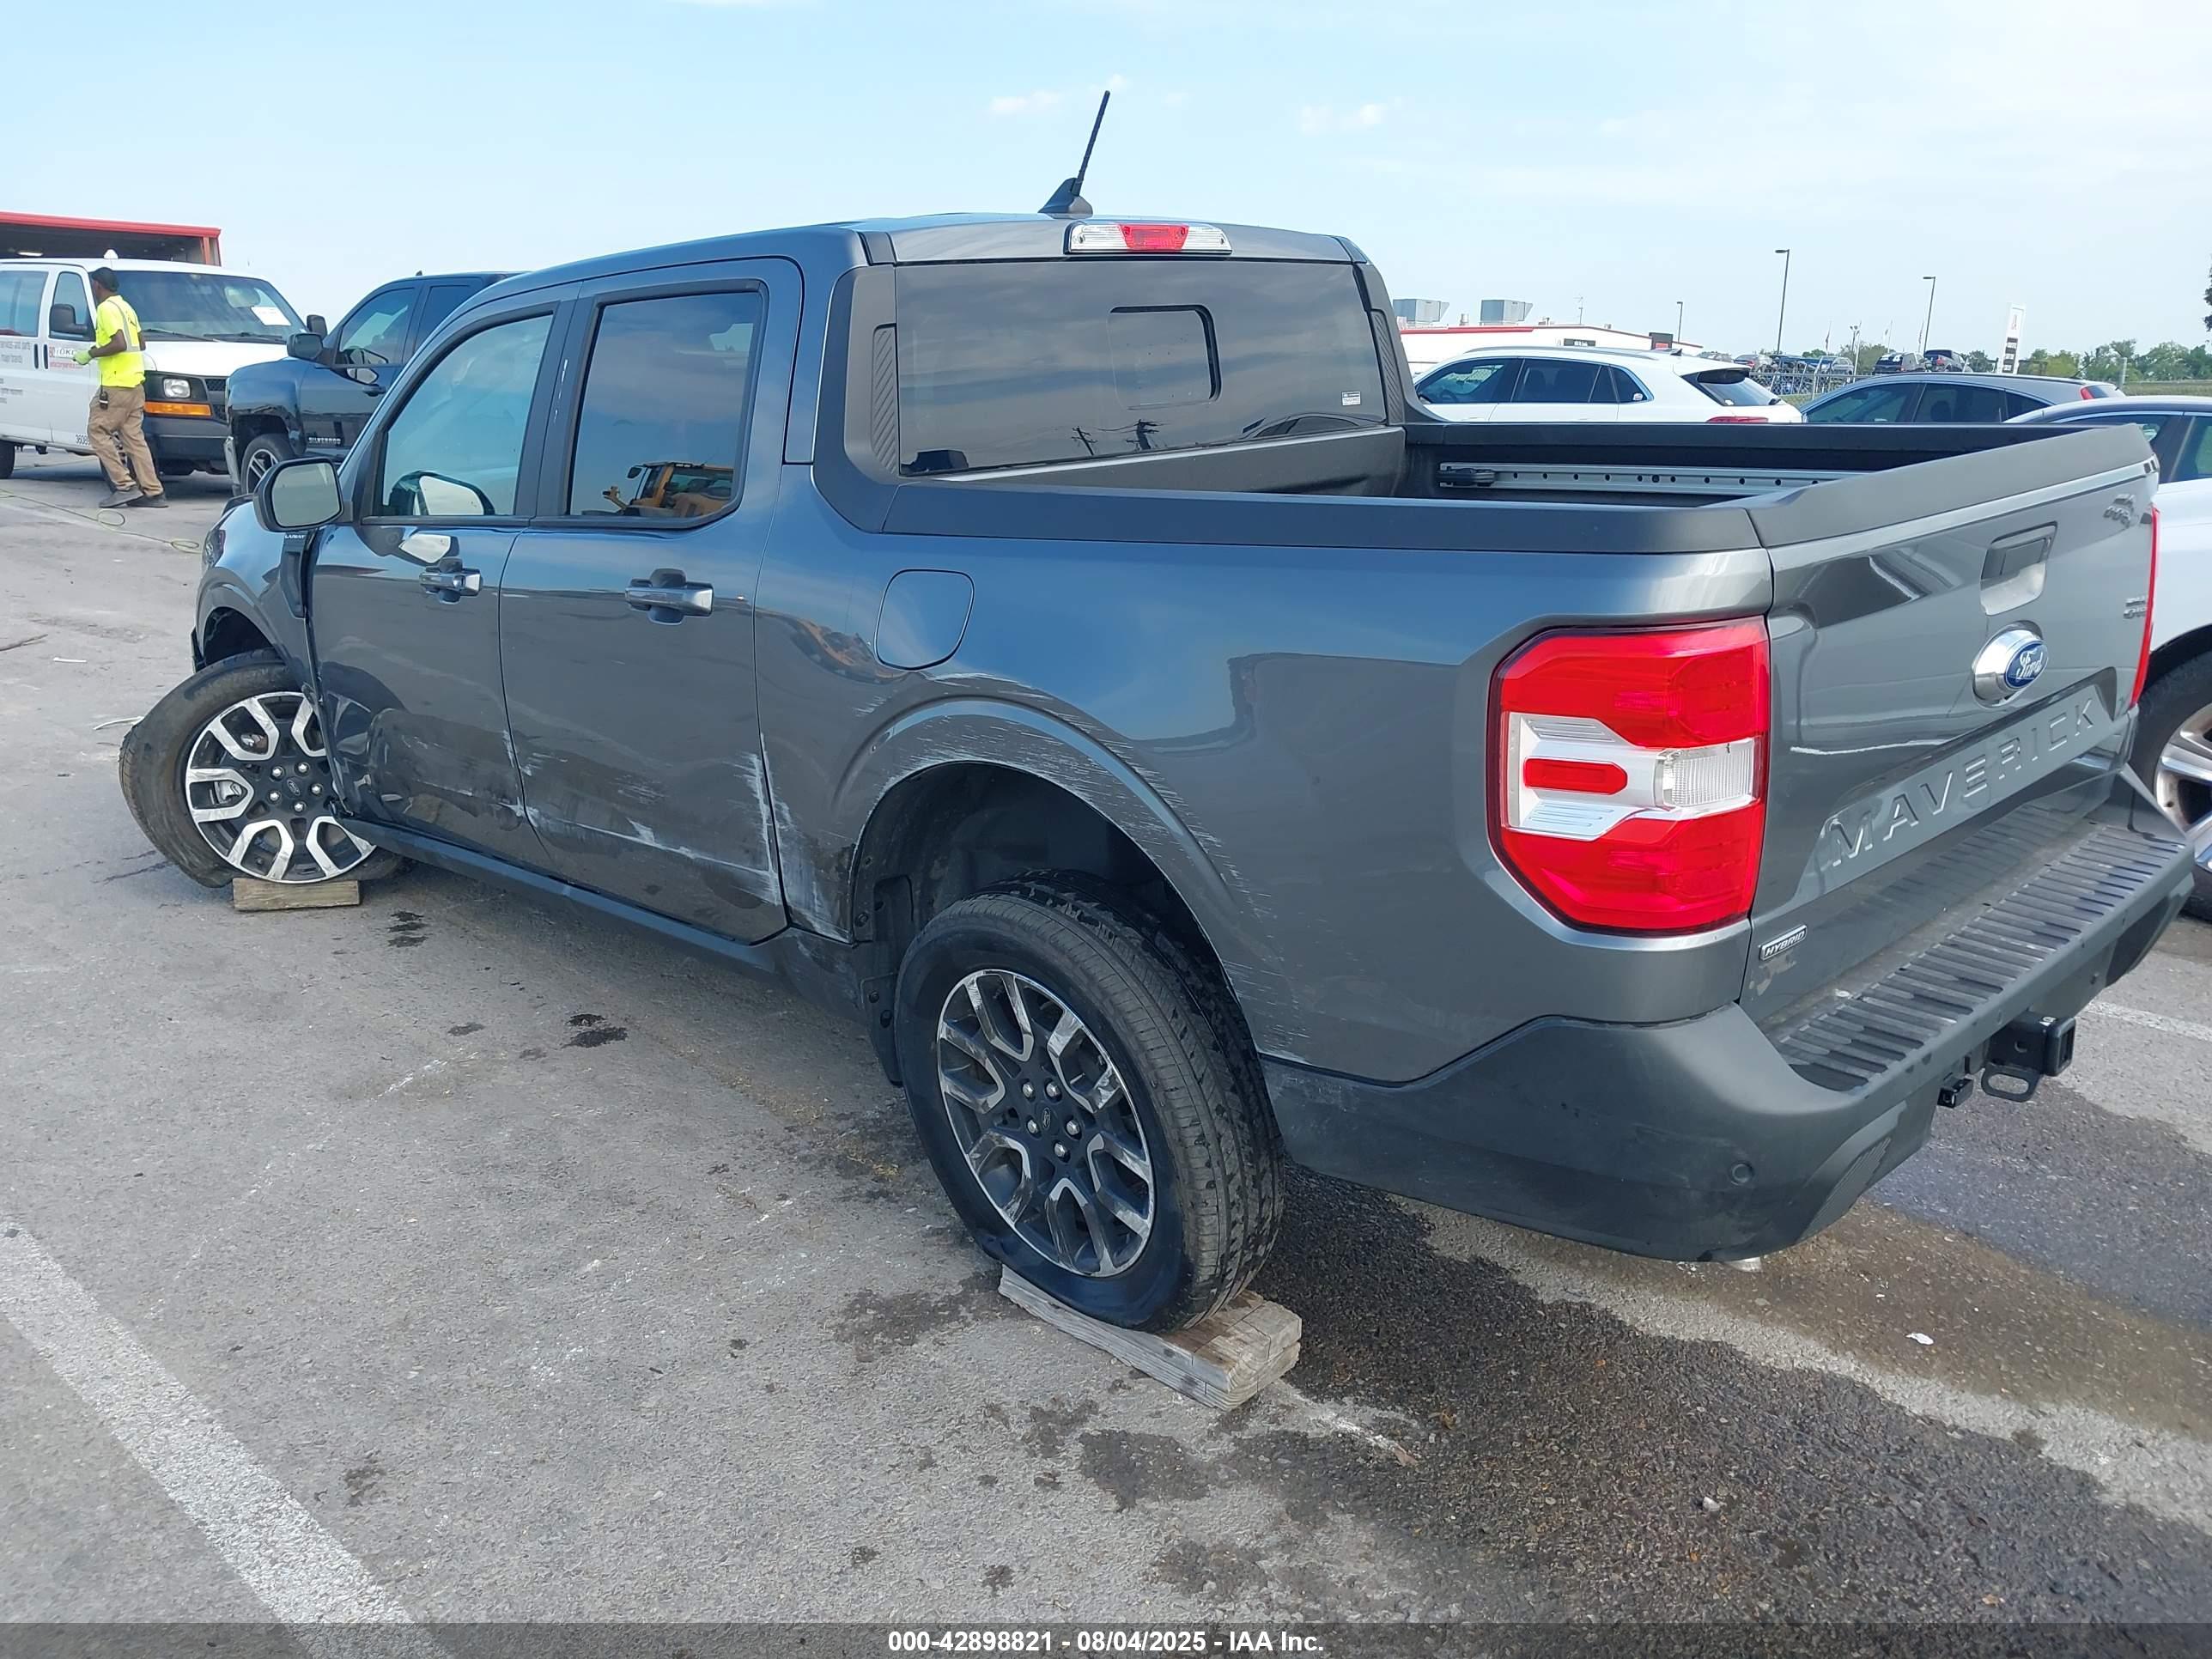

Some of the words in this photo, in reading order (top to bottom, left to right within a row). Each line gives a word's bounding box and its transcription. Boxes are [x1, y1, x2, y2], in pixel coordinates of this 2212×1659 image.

[2015, 647, 2044, 680] Ford
[1829, 698, 2094, 866] MAVERICK
[1765, 930, 1805, 957] HYBRID
